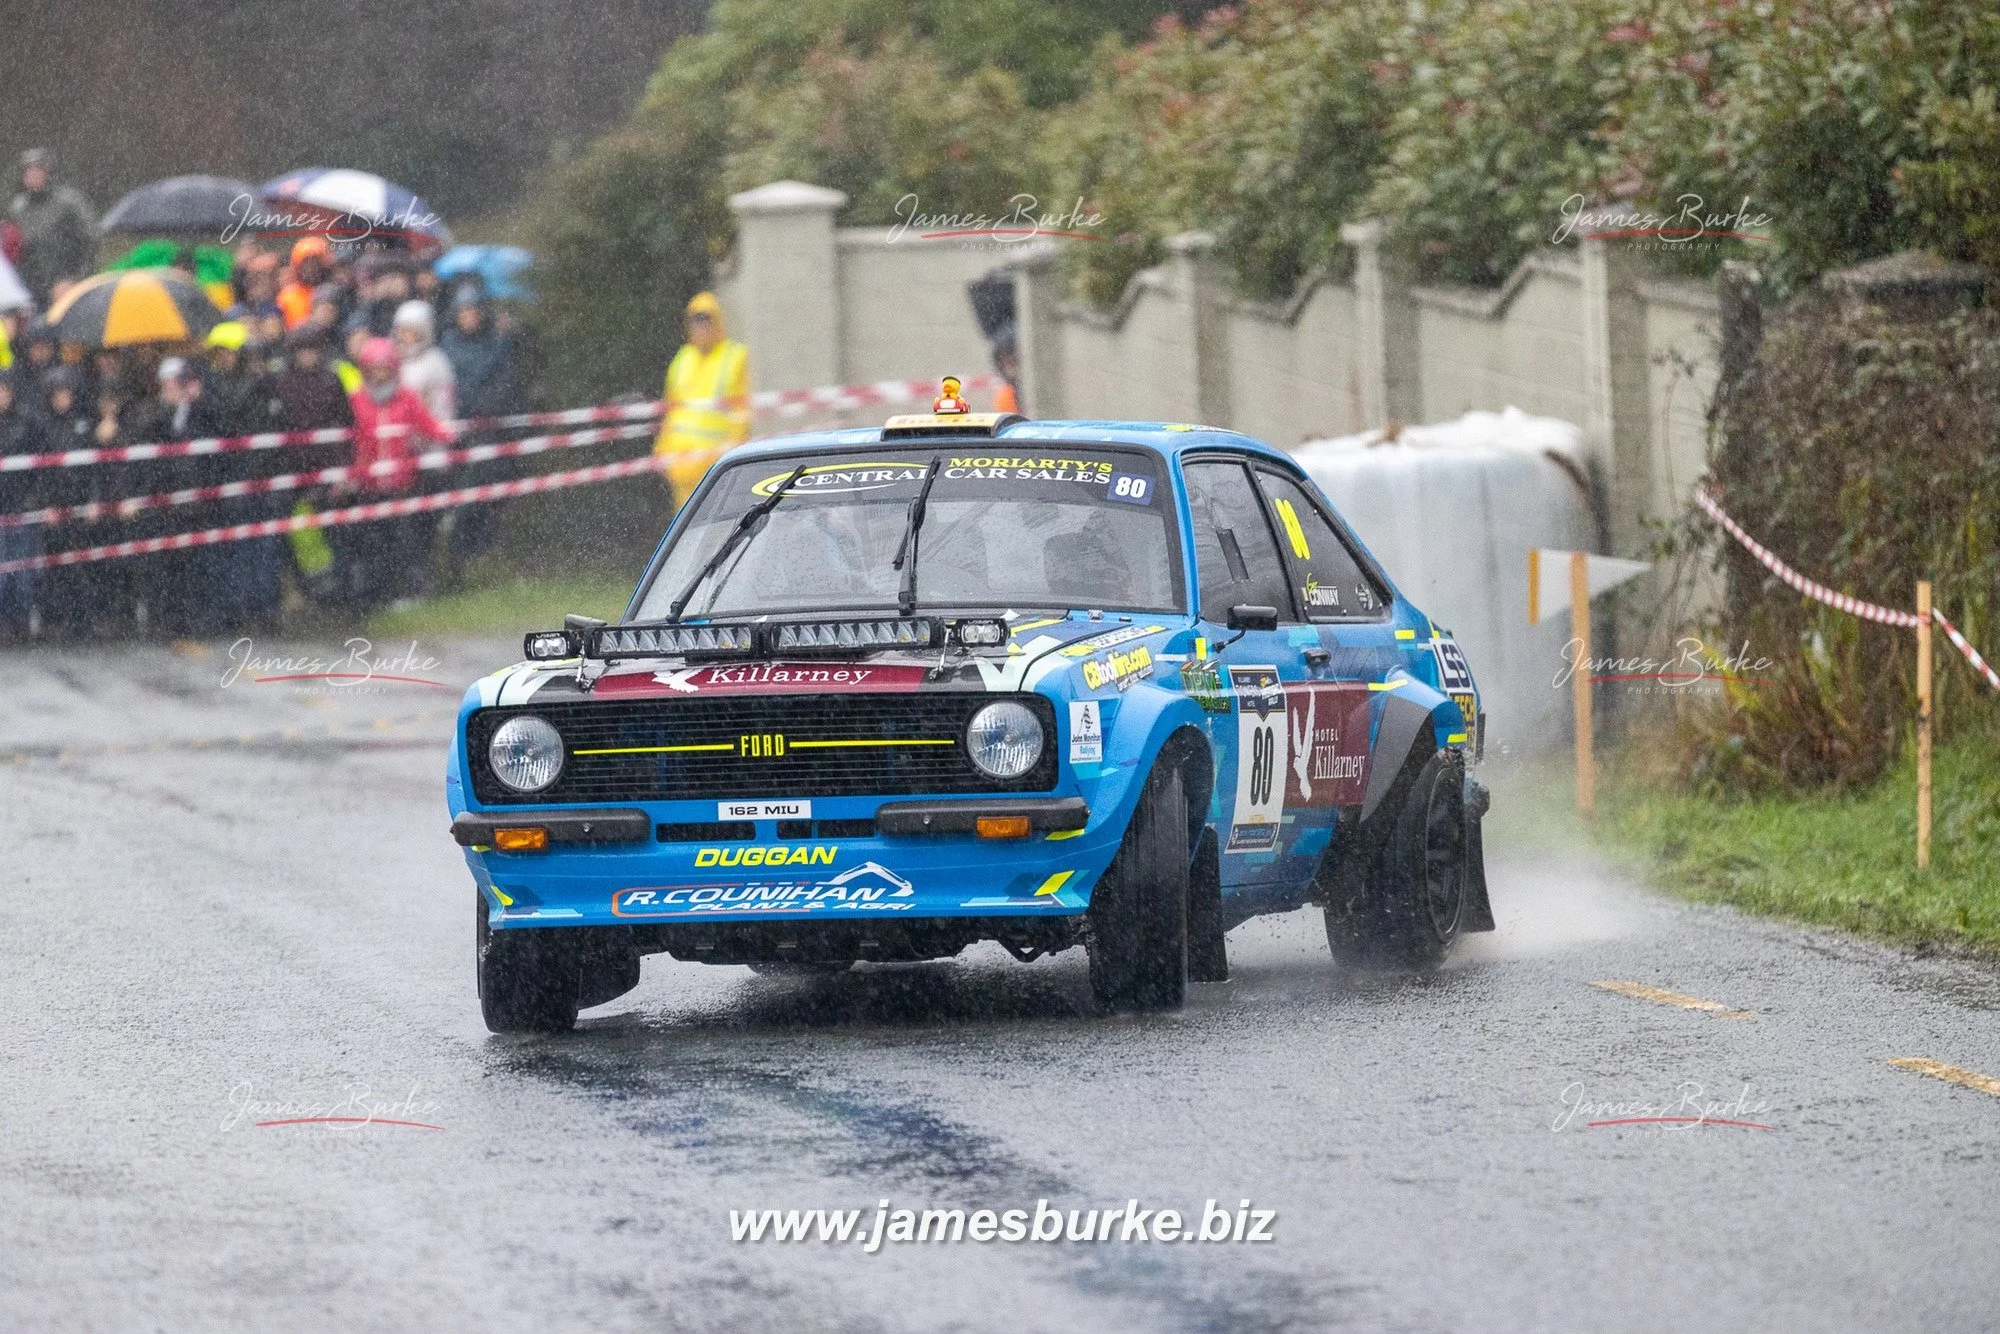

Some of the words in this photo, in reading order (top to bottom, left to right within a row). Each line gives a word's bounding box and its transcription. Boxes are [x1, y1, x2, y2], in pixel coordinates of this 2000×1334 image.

[948, 457, 1113, 473] MORIARTY'S
[944, 467, 1017, 481] CAR
[1024, 468, 1111, 485] SALES
[1114, 476, 1146, 498] 80
[706, 665, 872, 684] Killarney
[1314, 728, 1339, 741] HOTEL
[740, 734, 784, 757] FORD
[1250, 726, 1274, 806] 80
[1313, 745, 1365, 785] Killarney
[728, 805, 759, 816] 162
[764, 804, 800, 816] MIU
[694, 846, 838, 868] DUGGAN
[623, 885, 887, 906] R.COUNIHAN
